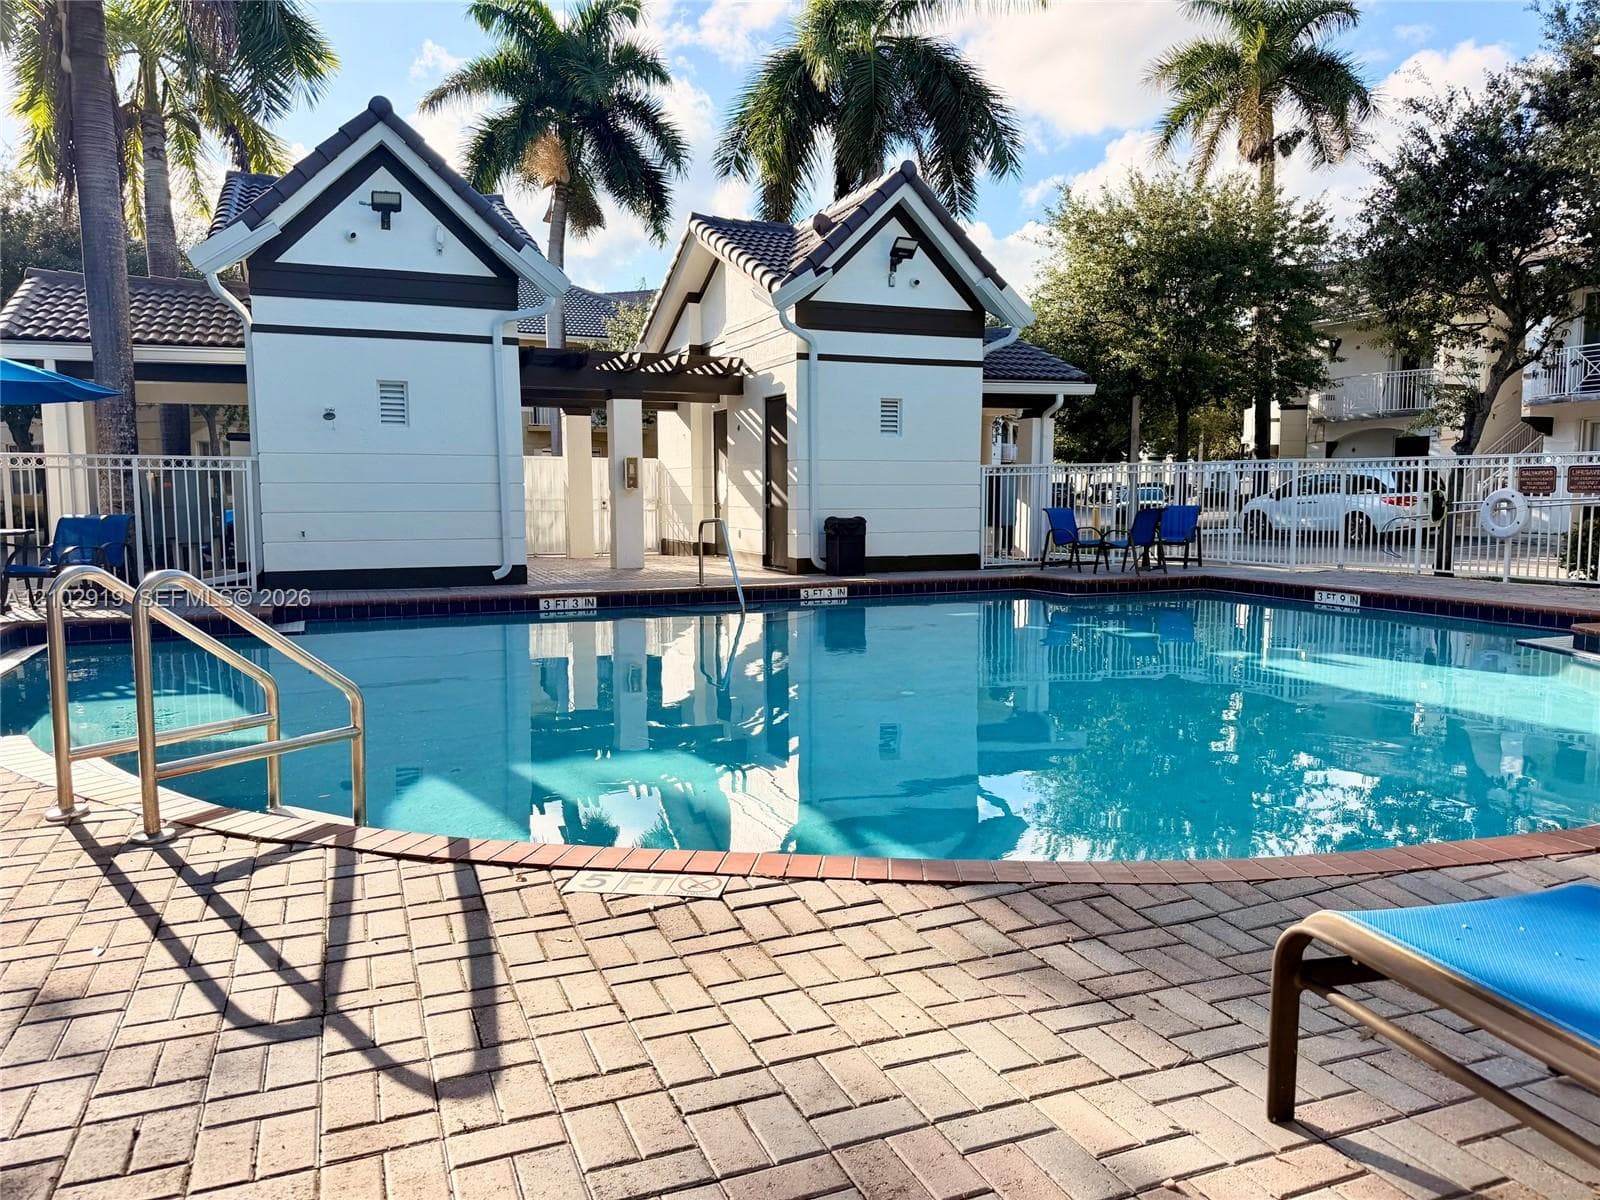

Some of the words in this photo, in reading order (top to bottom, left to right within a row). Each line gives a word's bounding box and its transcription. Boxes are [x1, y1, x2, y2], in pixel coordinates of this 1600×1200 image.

[837, 588, 846, 597] IN
[1317, 591, 1323, 601] 3
[1350, 595, 1359, 605] IN
[543, 599, 550, 610] 3
[555, 599, 567, 609] FT
[572, 598, 579, 609] 3
[584, 597, 595, 607] IN
[578, 873, 612, 889] 5
[620, 875, 674, 892] FT
